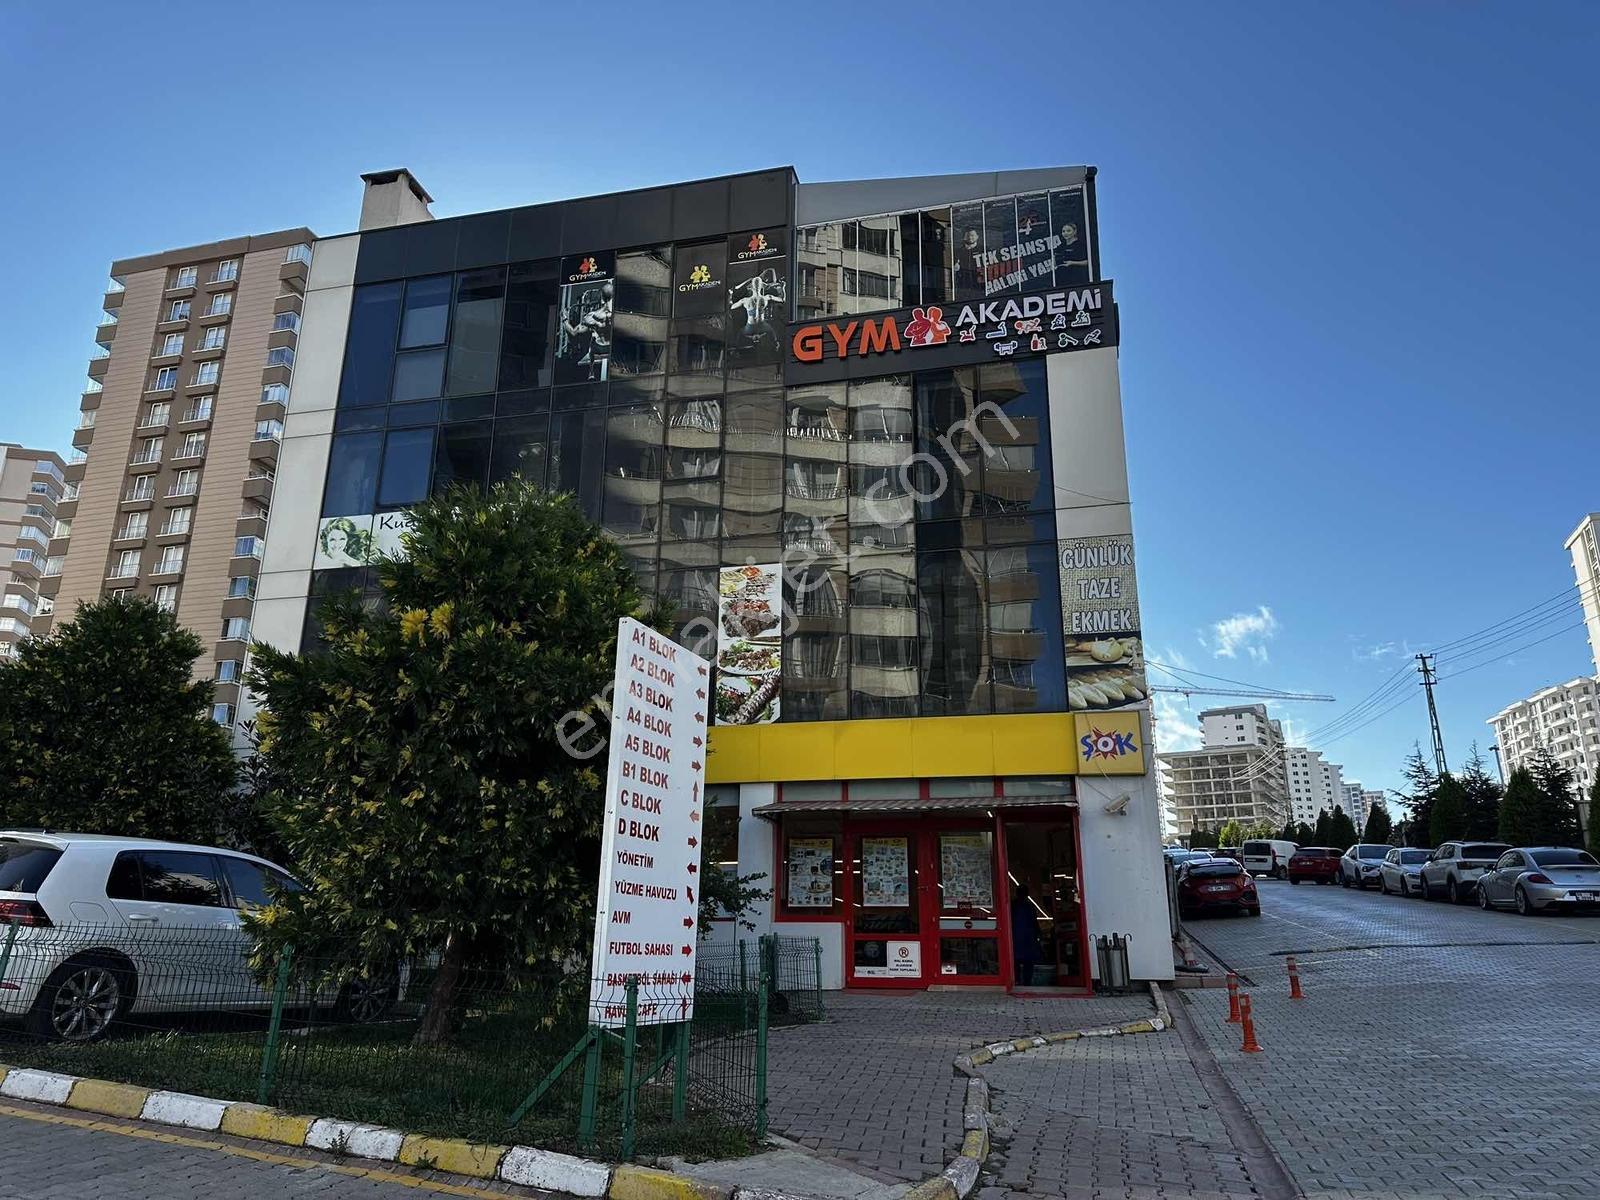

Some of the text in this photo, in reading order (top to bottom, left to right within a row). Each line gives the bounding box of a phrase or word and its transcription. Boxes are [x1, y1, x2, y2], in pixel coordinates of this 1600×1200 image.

[973, 235, 1062, 268] TEK SEANSTA
[792, 316, 901, 364] GYM
[1061, 540, 1133, 570] GÜNLÜK
[1077, 577, 1121, 600] TAZE
[1072, 609, 1132, 633] EKMEK
[632, 628, 677, 663] A1 BLOK
[631, 653, 675, 688] A2 BLOK
[629, 680, 673, 712] A3 BLOK
[627, 706, 672, 738] A4 BLOK
[625, 734, 671, 764] A5 BLOK
[623, 761, 668, 790] B1 BLOK
[620, 789, 661, 815] C BLOK
[618, 818, 660, 842] D BLOK
[616, 850, 654, 869] YÖNETİM
[615, 879, 677, 901] YÜZME HAVUZU
[612, 911, 631, 925] AVM
[609, 942, 674, 957] FUTBOL SAHASI
